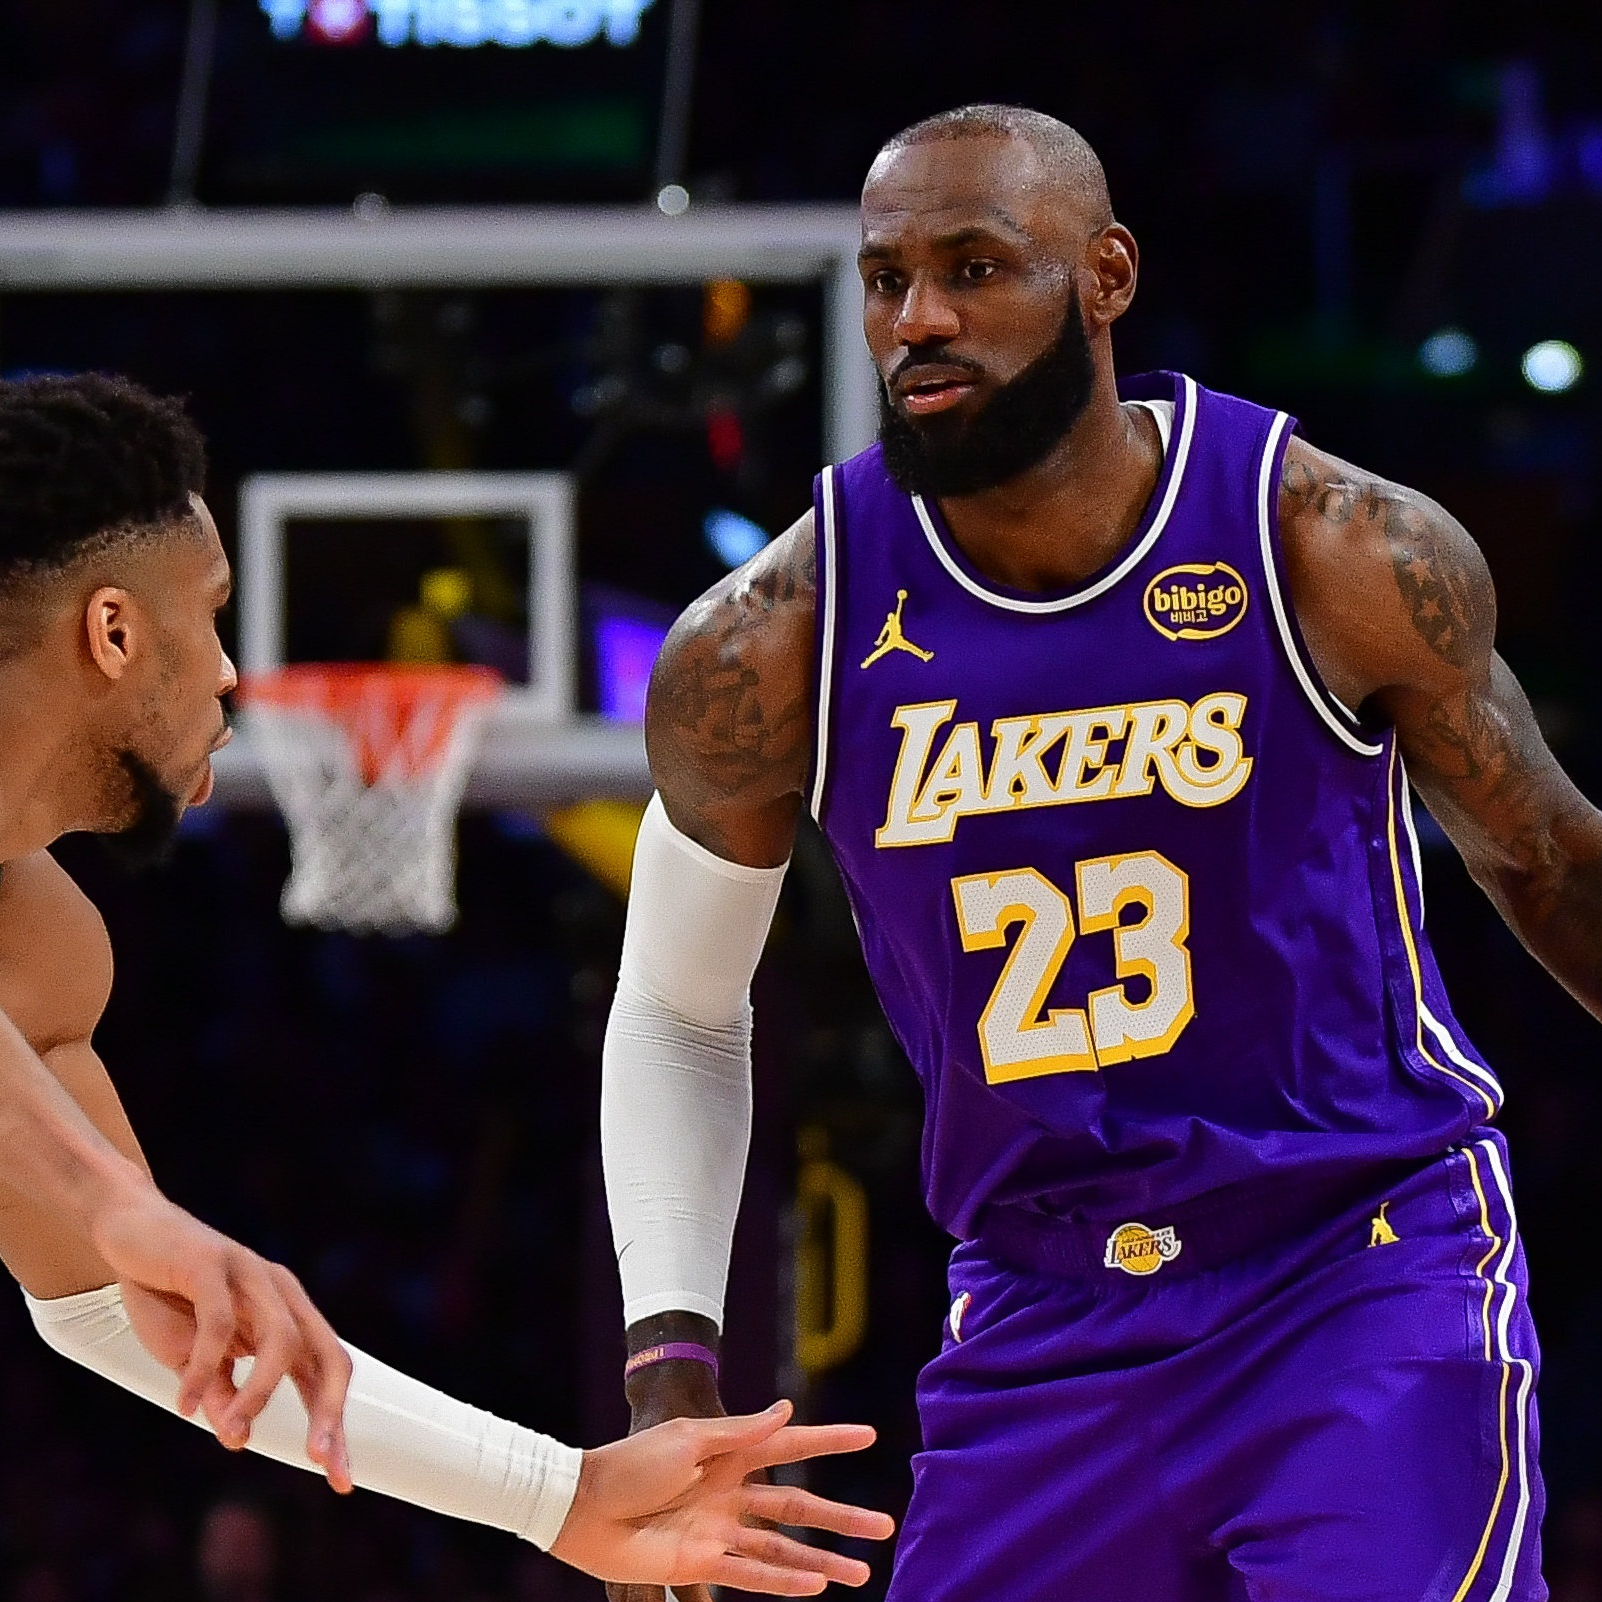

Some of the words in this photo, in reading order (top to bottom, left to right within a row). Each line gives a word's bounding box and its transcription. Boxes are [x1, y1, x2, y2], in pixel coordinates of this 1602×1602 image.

[1153, 583, 1241, 615] bibigo
[1170, 609, 1208, 624] 비비고
[875, 692, 1253, 849] LAKERS
[950, 849, 1196, 1085] 23
[1107, 1236, 1179, 1264] LAKERS
